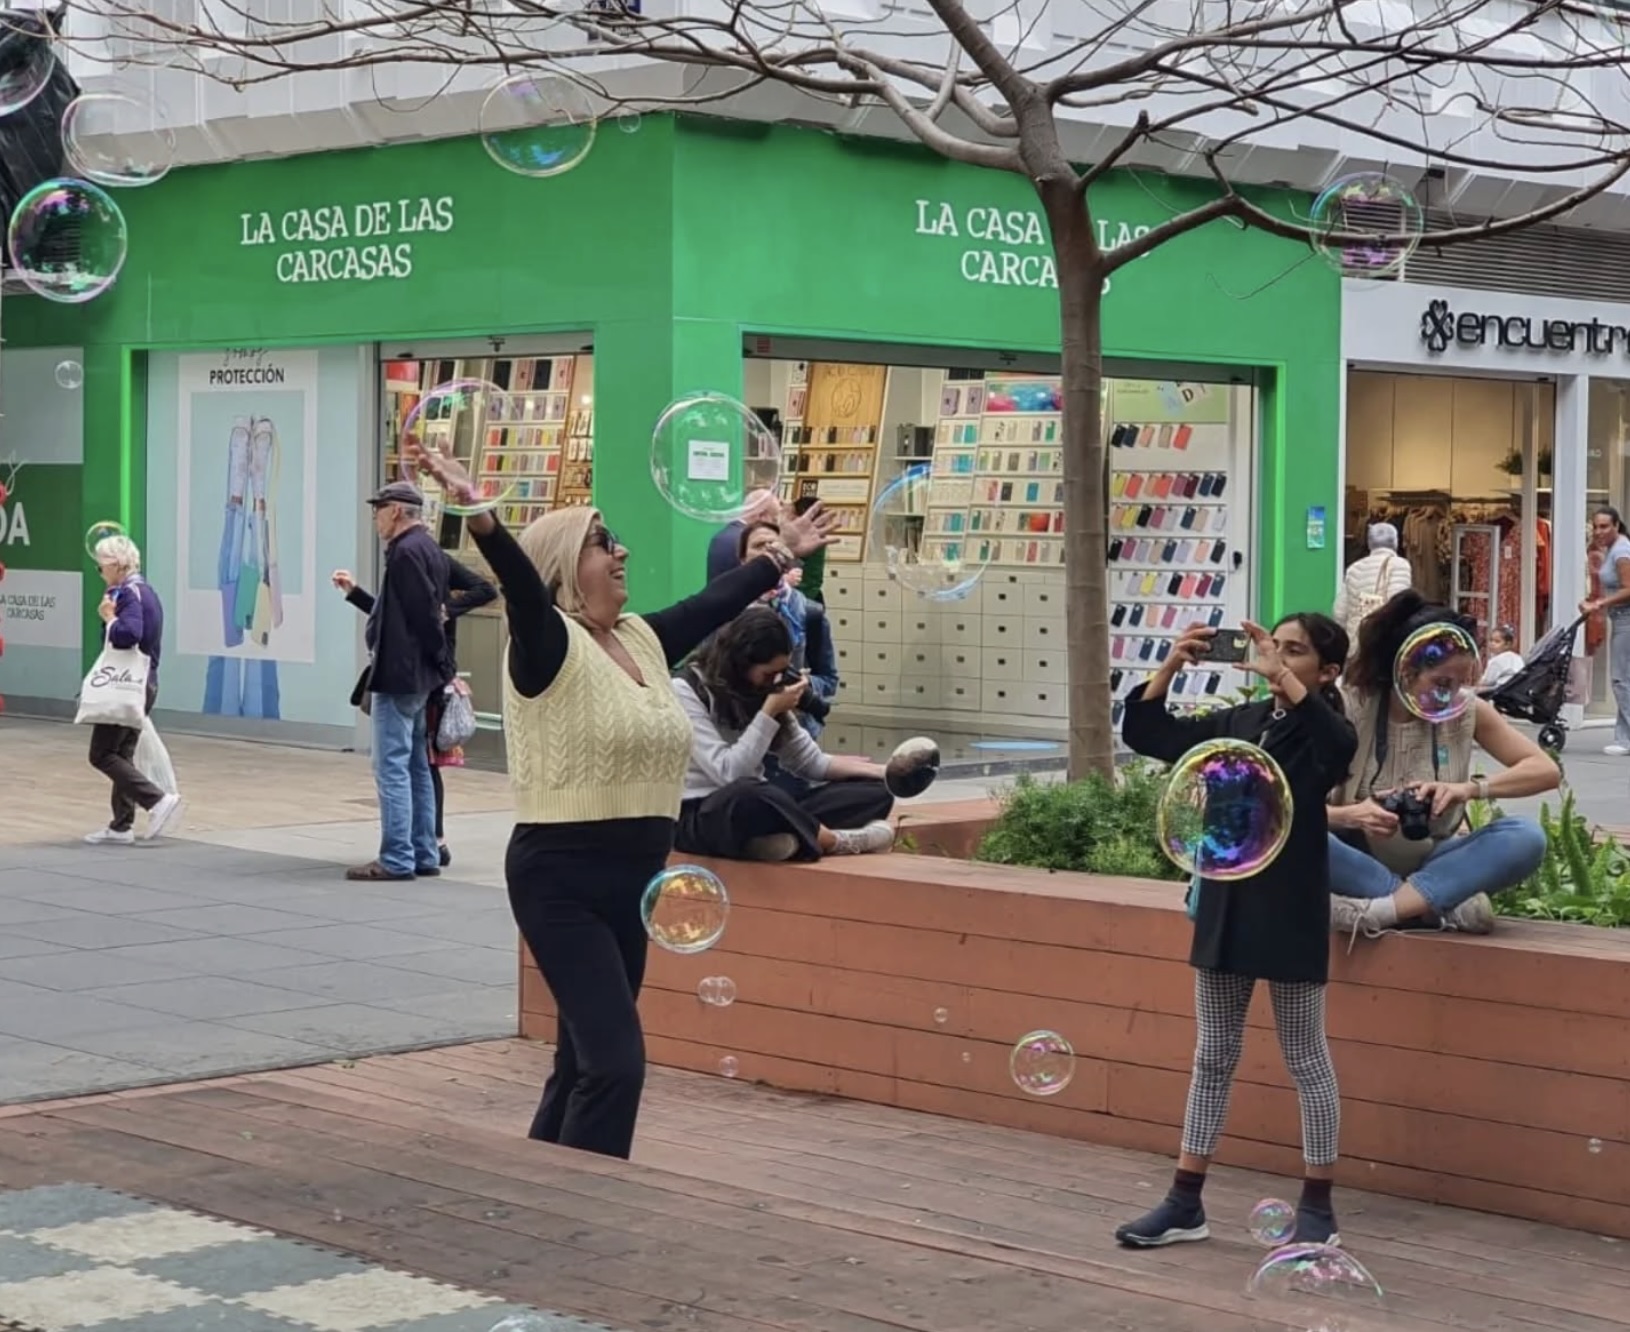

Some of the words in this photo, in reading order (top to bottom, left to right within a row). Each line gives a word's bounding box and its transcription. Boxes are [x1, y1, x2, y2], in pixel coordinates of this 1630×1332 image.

[241, 213, 275, 245] LA
[282, 206, 349, 241] CASA
[355, 202, 391, 237] DE
[398, 197, 453, 232] LAS
[916, 200, 958, 236] LA
[967, 208, 1045, 245] CASA
[276, 243, 412, 282] CARCASAS
[961, 250, 1111, 295] CARCA
[1457, 312, 1630, 354] encuentr
[209, 363, 285, 384] PROTECCIÓN
